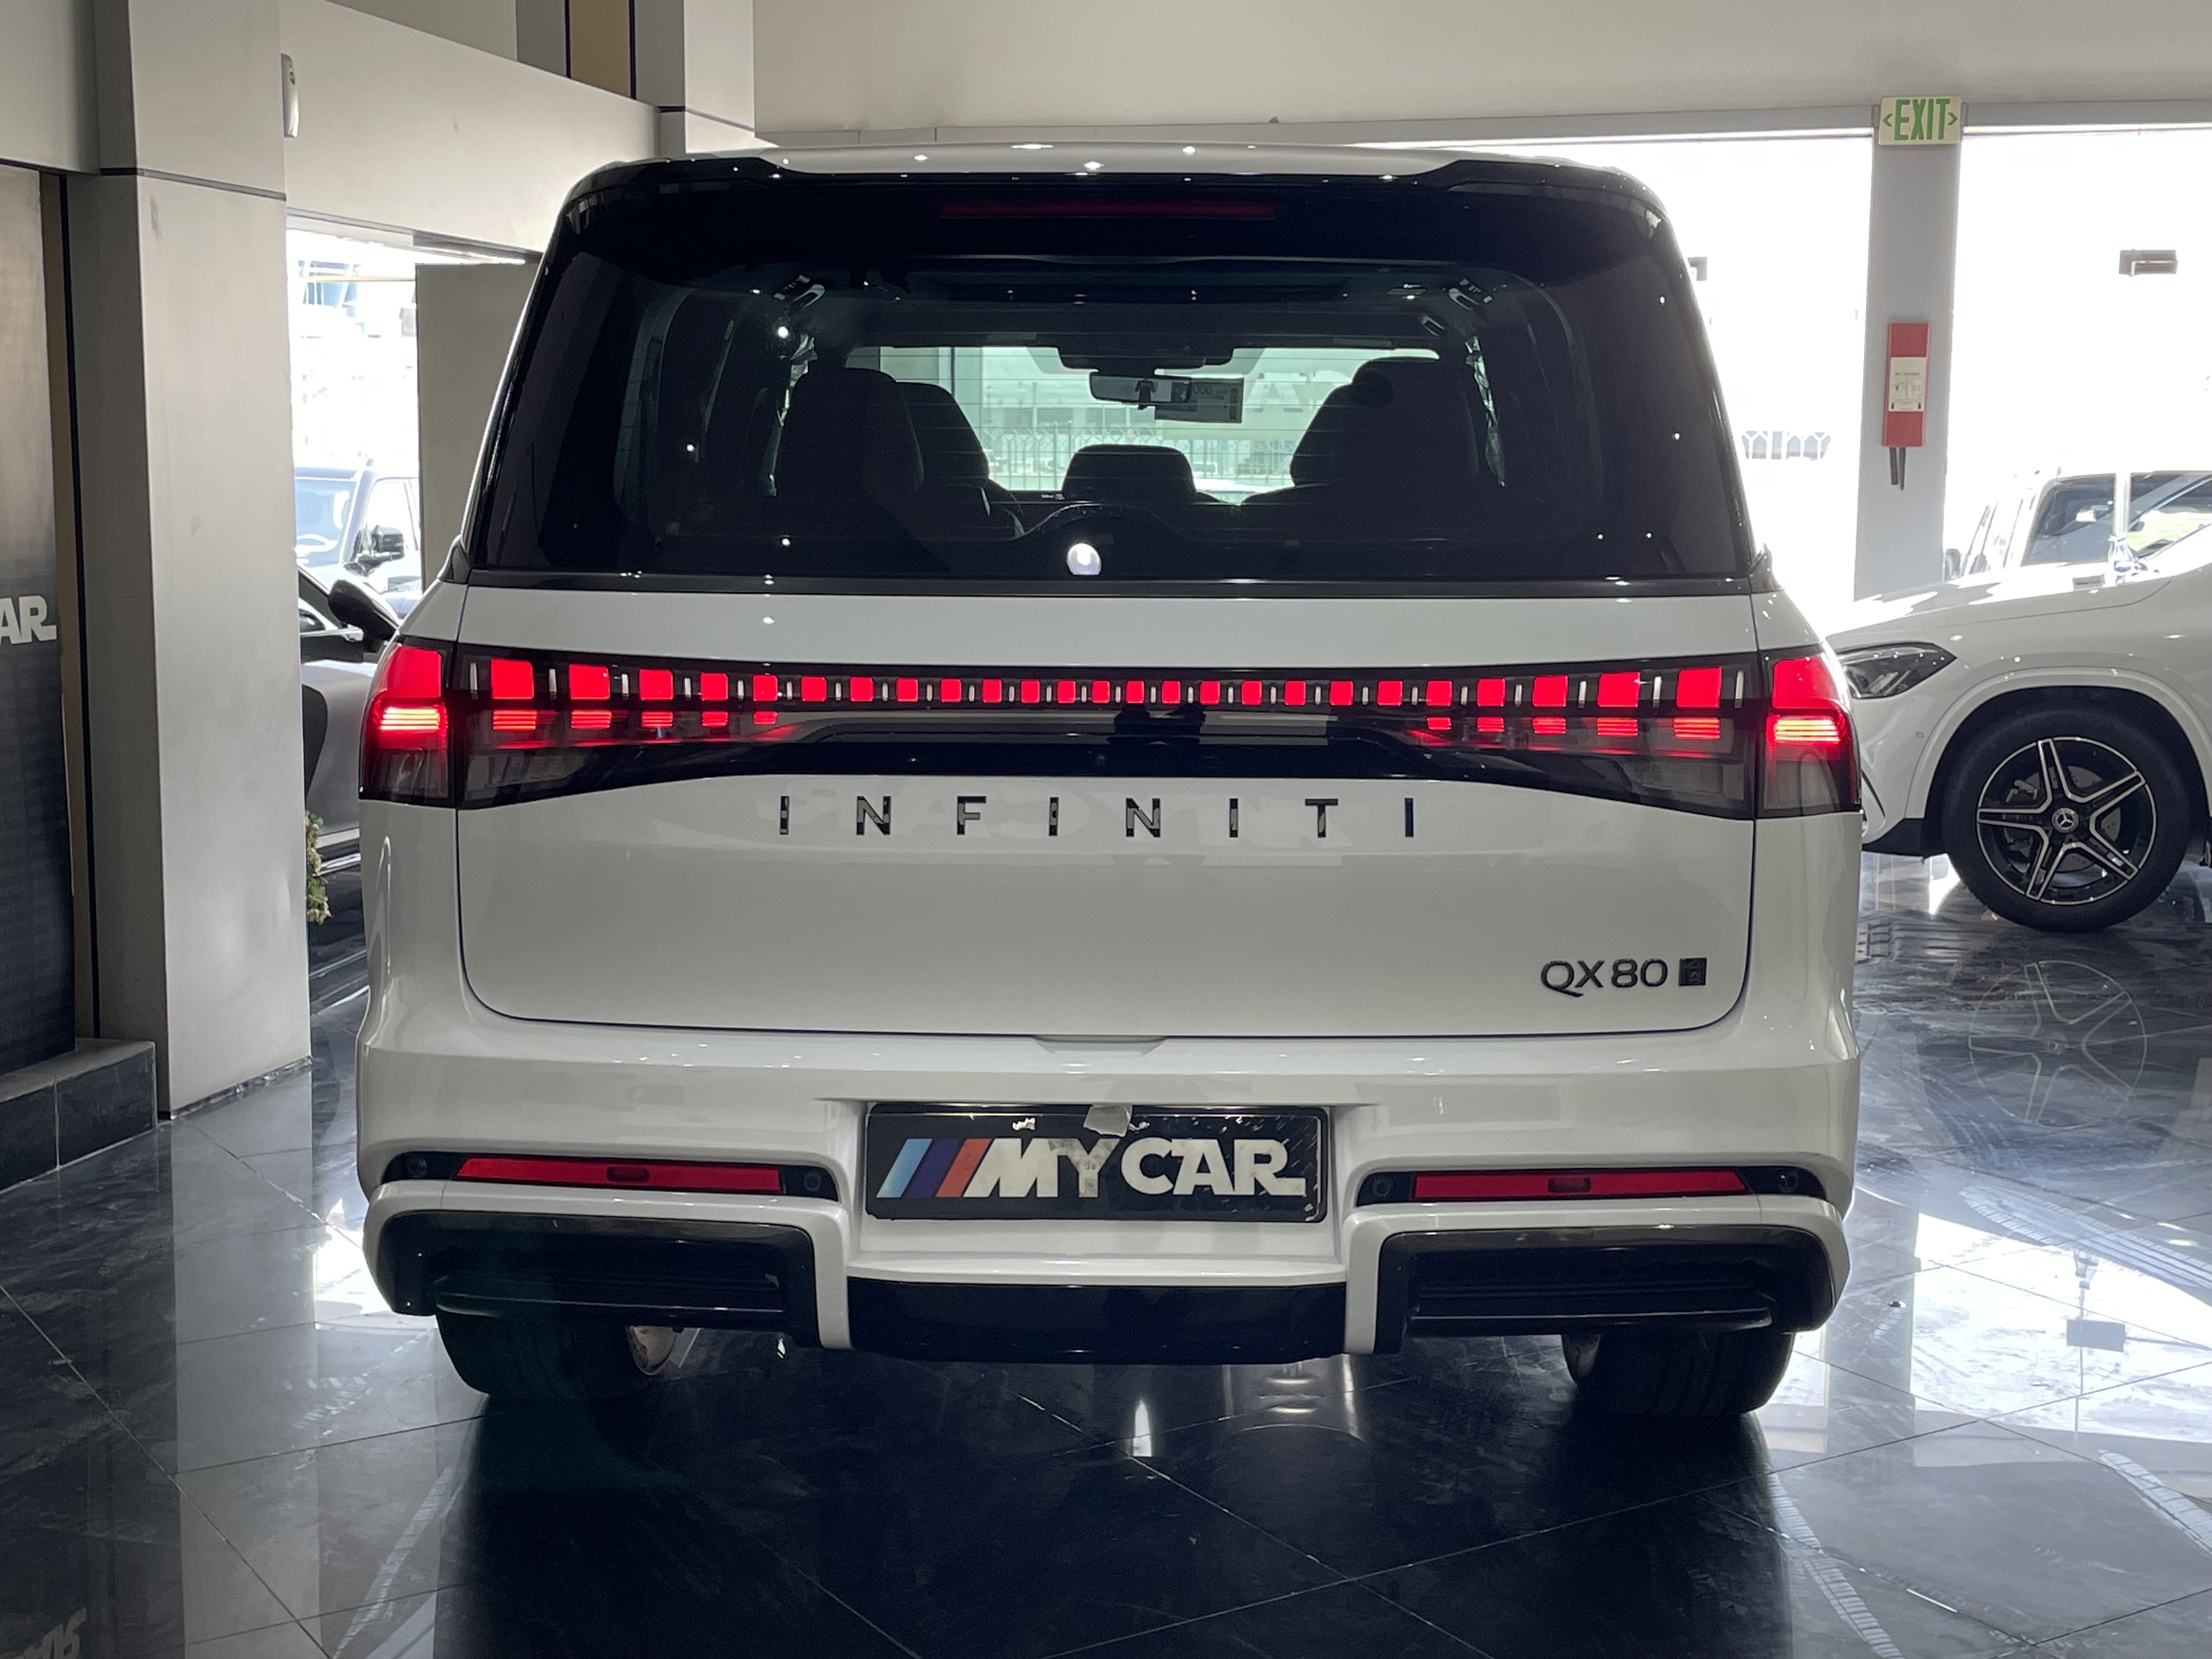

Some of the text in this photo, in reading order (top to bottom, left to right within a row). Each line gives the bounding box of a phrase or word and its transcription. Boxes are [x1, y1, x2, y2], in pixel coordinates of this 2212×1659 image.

[1894, 99, 1950, 140] EXIT
[780, 796, 1414, 837] INFINITI
[1541, 958, 1668, 997] QX80
